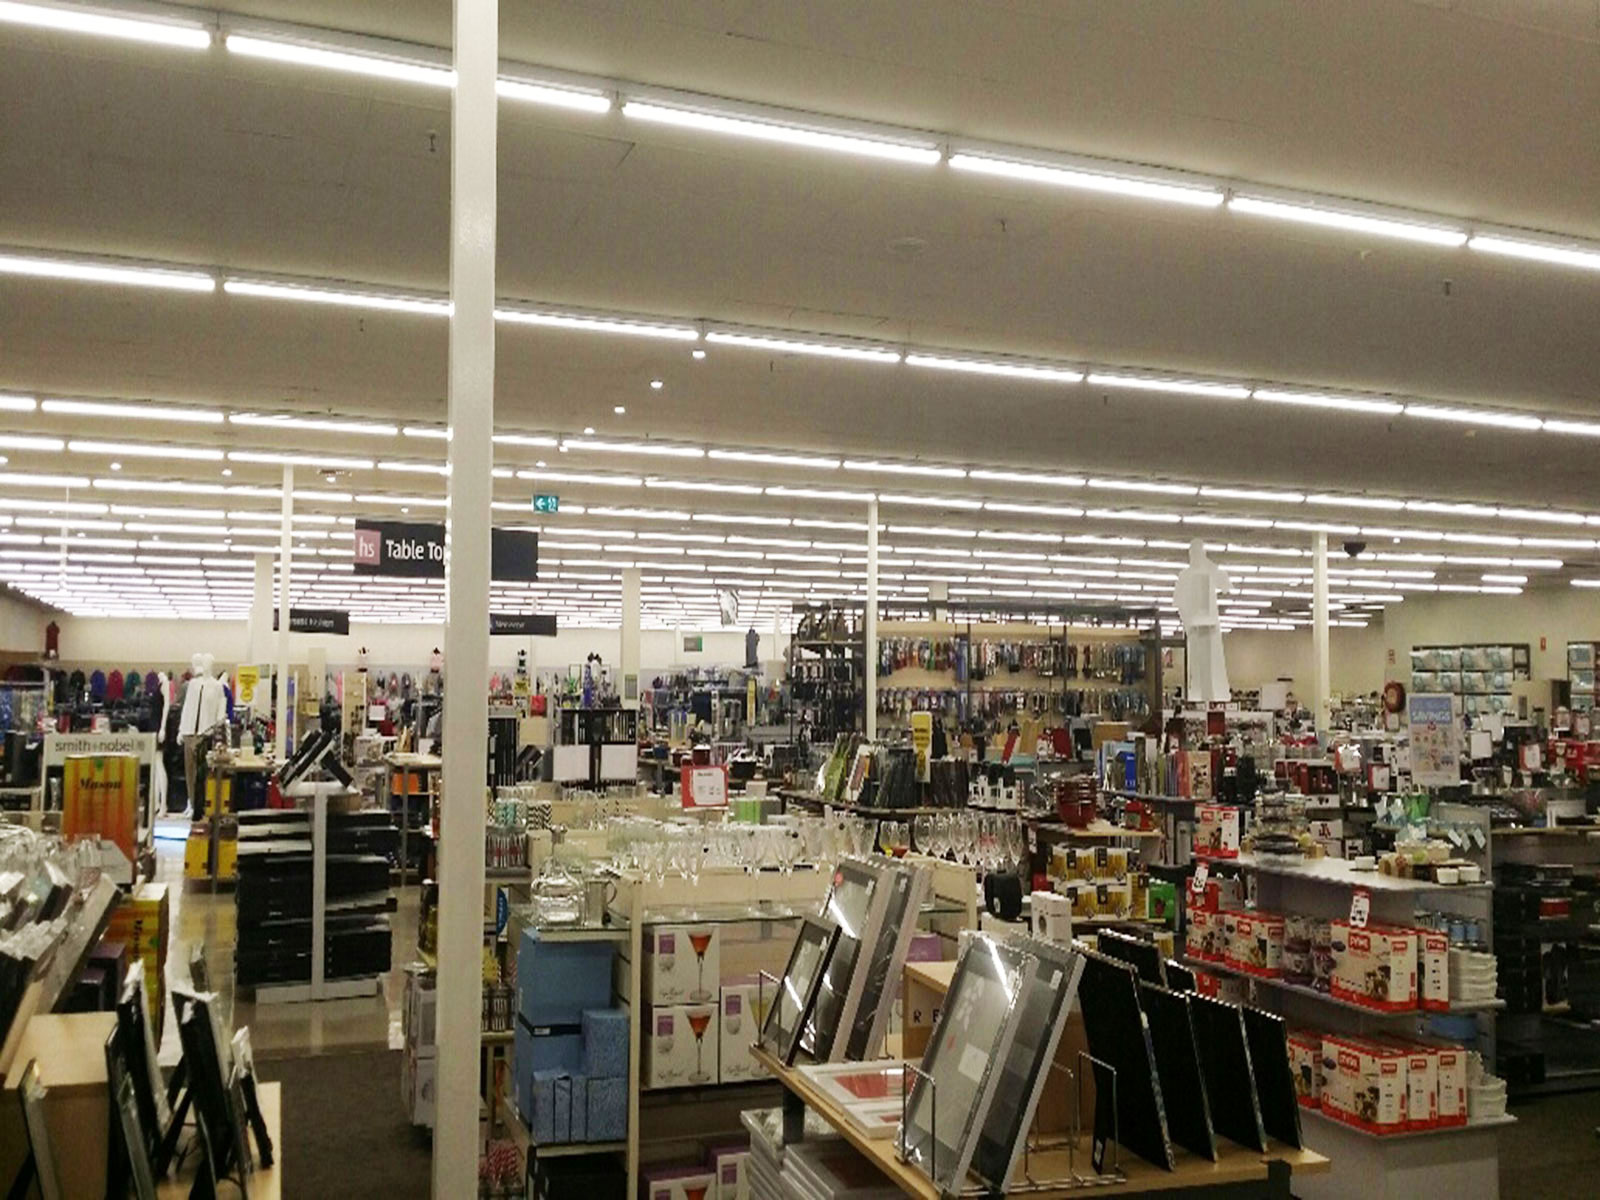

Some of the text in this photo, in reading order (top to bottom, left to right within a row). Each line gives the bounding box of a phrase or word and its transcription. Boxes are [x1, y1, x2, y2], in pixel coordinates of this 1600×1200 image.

[359, 536, 375, 558] hs
[385, 538, 446, 566] Table To
